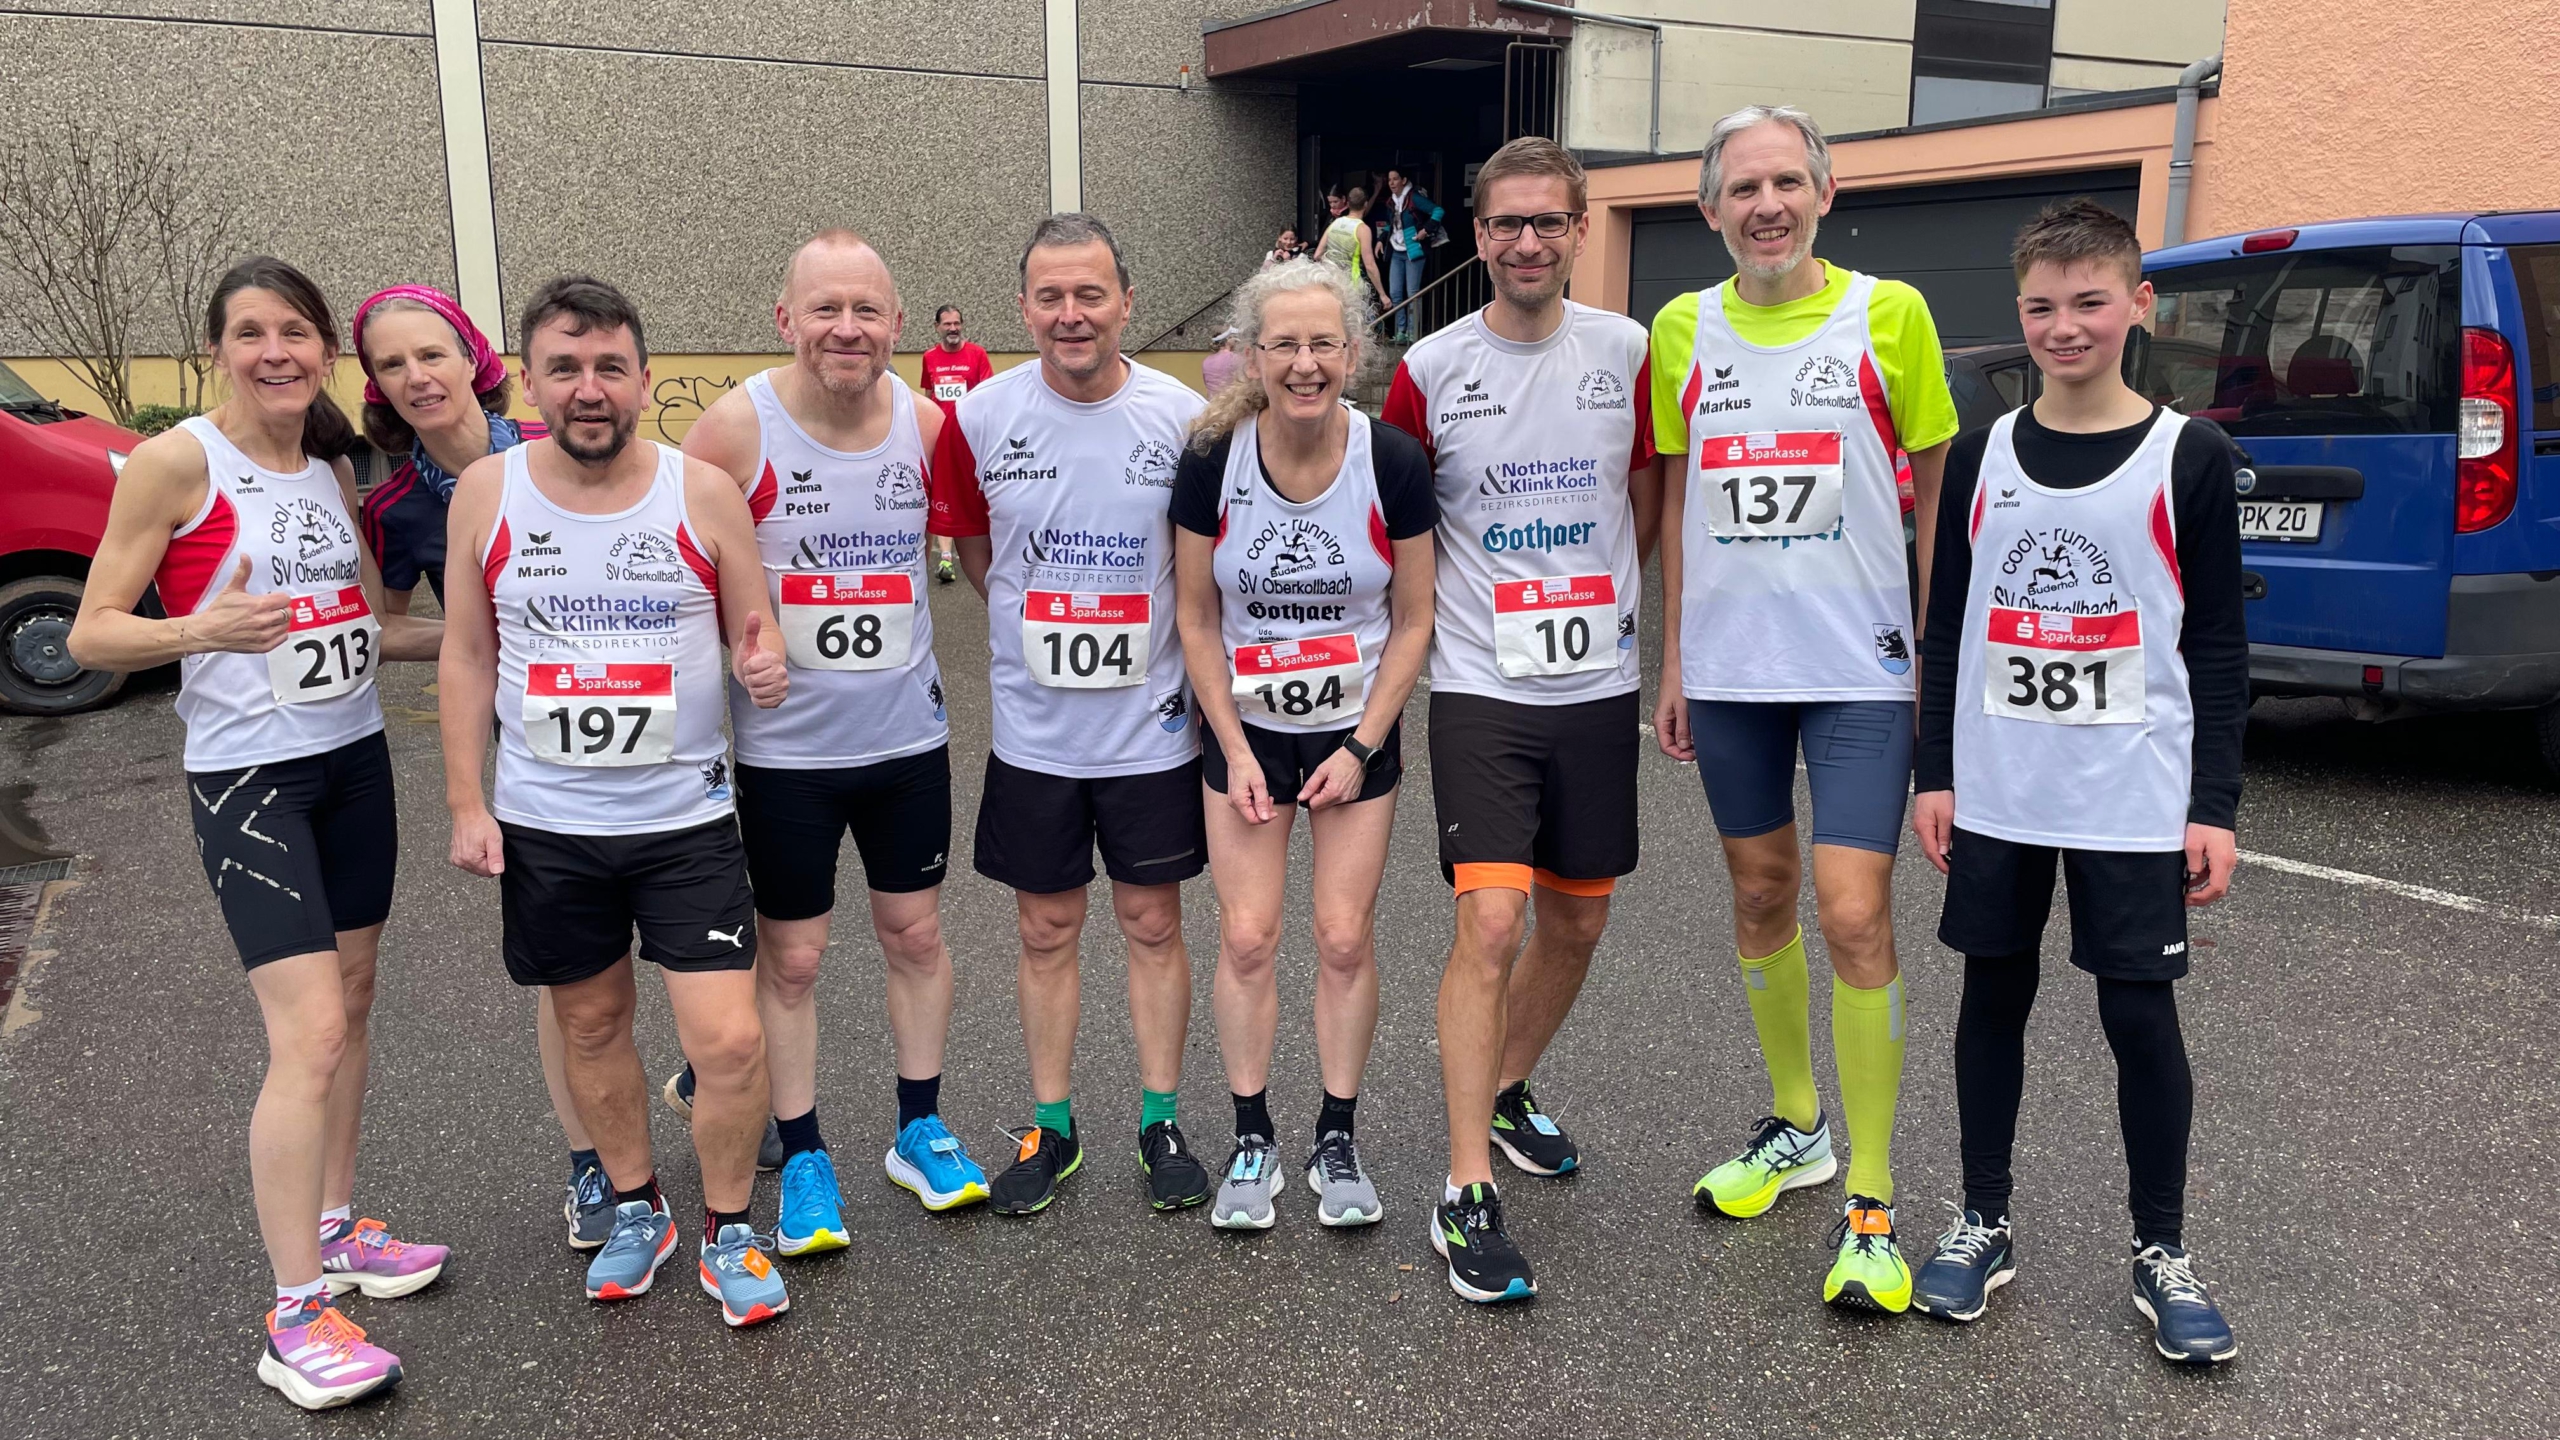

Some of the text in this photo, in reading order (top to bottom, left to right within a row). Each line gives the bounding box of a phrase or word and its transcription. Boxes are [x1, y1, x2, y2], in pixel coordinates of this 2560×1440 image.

[1578, 371, 1591, 391] cool
[1597, 369, 1623, 392] running
[1795, 356, 1816, 382] cool
[1824, 355, 1857, 387] running
[939, 386, 962, 398] 166
[1708, 378, 1740, 393] erima
[1456, 392, 1489, 404] erima
[1576, 395, 1586, 410] SV
[1699, 396, 1752, 416] Markus
[1790, 387, 1803, 407] SV
[1805, 391, 1860, 410] Oberkollbach
[1440, 404, 1508, 424] Domenik
[1003, 450, 1035, 461] erima
[1129, 440, 1146, 463] cool
[1153, 440, 1179, 470] running
[1748, 447, 1809, 462] Sparkasse
[876, 463, 891, 488] cool
[896, 461, 923, 490] running
[984, 466, 1057, 482] Reinhard
[1502, 457, 1597, 478] Nothacker
[1125, 467, 1136, 485] SV
[1138, 473, 1175, 489] Oberkollba
[1510, 473, 1597, 494] Klink Koch
[236, 485, 265, 495] erima
[785, 483, 823, 495] erima
[785, 502, 831, 516] Peter
[874, 493, 886, 511] SV
[1230, 497, 1253, 506] erima
[1481, 492, 1598, 511] BEZIRKSDIREKTION
[1721, 475, 1817, 525] 137
[1993, 499, 2021, 509] erima
[271, 502, 291, 544] cool
[298, 498, 353, 545] running
[2241, 506, 2307, 531] PK 20
[820, 530, 921, 550] Nothacker
[1045, 528, 1148, 549] Nothacker
[1247, 520, 1278, 561] cool
[1292, 518, 1345, 566] running
[1482, 516, 1597, 554] Gothaer
[299, 540, 335, 562] Buderhof
[521, 545, 561, 557] erima
[609, 532, 630, 557] cool
[638, 532, 677, 562] running
[1050, 547, 1144, 567] Klink Koch
[2002, 529, 2037, 575] cool
[2053, 527, 2113, 585] running
[828, 547, 918, 568] Klink Koch
[271, 555, 291, 587] SV
[517, 565, 568, 578] Mario
[606, 562, 620, 580] SV
[623, 566, 684, 583] Oberkollbach
[1021, 569, 1144, 584] BEZIRKSDIREKTION
[1270, 560, 1318, 578] Buderhof
[1238, 568, 1353, 595] SV Oberkollbach
[2027, 578, 2080, 596] Buderhof
[549, 594, 680, 613] Nothacker
[833, 588, 887, 601] Sparkasse
[1543, 590, 1595, 604] Sparkasse
[319, 602, 360, 621] Sparkasse
[1070, 607, 1125, 620] Sparkasse
[1246, 600, 1346, 625] Gothaer
[561, 614, 677, 632] Klink Koch
[1258, 628, 1273, 636] Udo
[529, 635, 679, 649] BEZIRKSDIREKTION
[816, 613, 883, 660] 68
[1535, 616, 1590, 663] 10
[2040, 629, 2107, 645] Sparkasse
[294, 628, 370, 690] 213
[1043, 632, 1133, 677] 104
[1277, 651, 1331, 668] Sparkasse
[577, 678, 642, 691] Sparkasse
[2007, 656, 2108, 712] 381
[1255, 674, 1345, 716] 184
[548, 706, 652, 754] 197
[2162, 941, 2185, 955] JAKO
